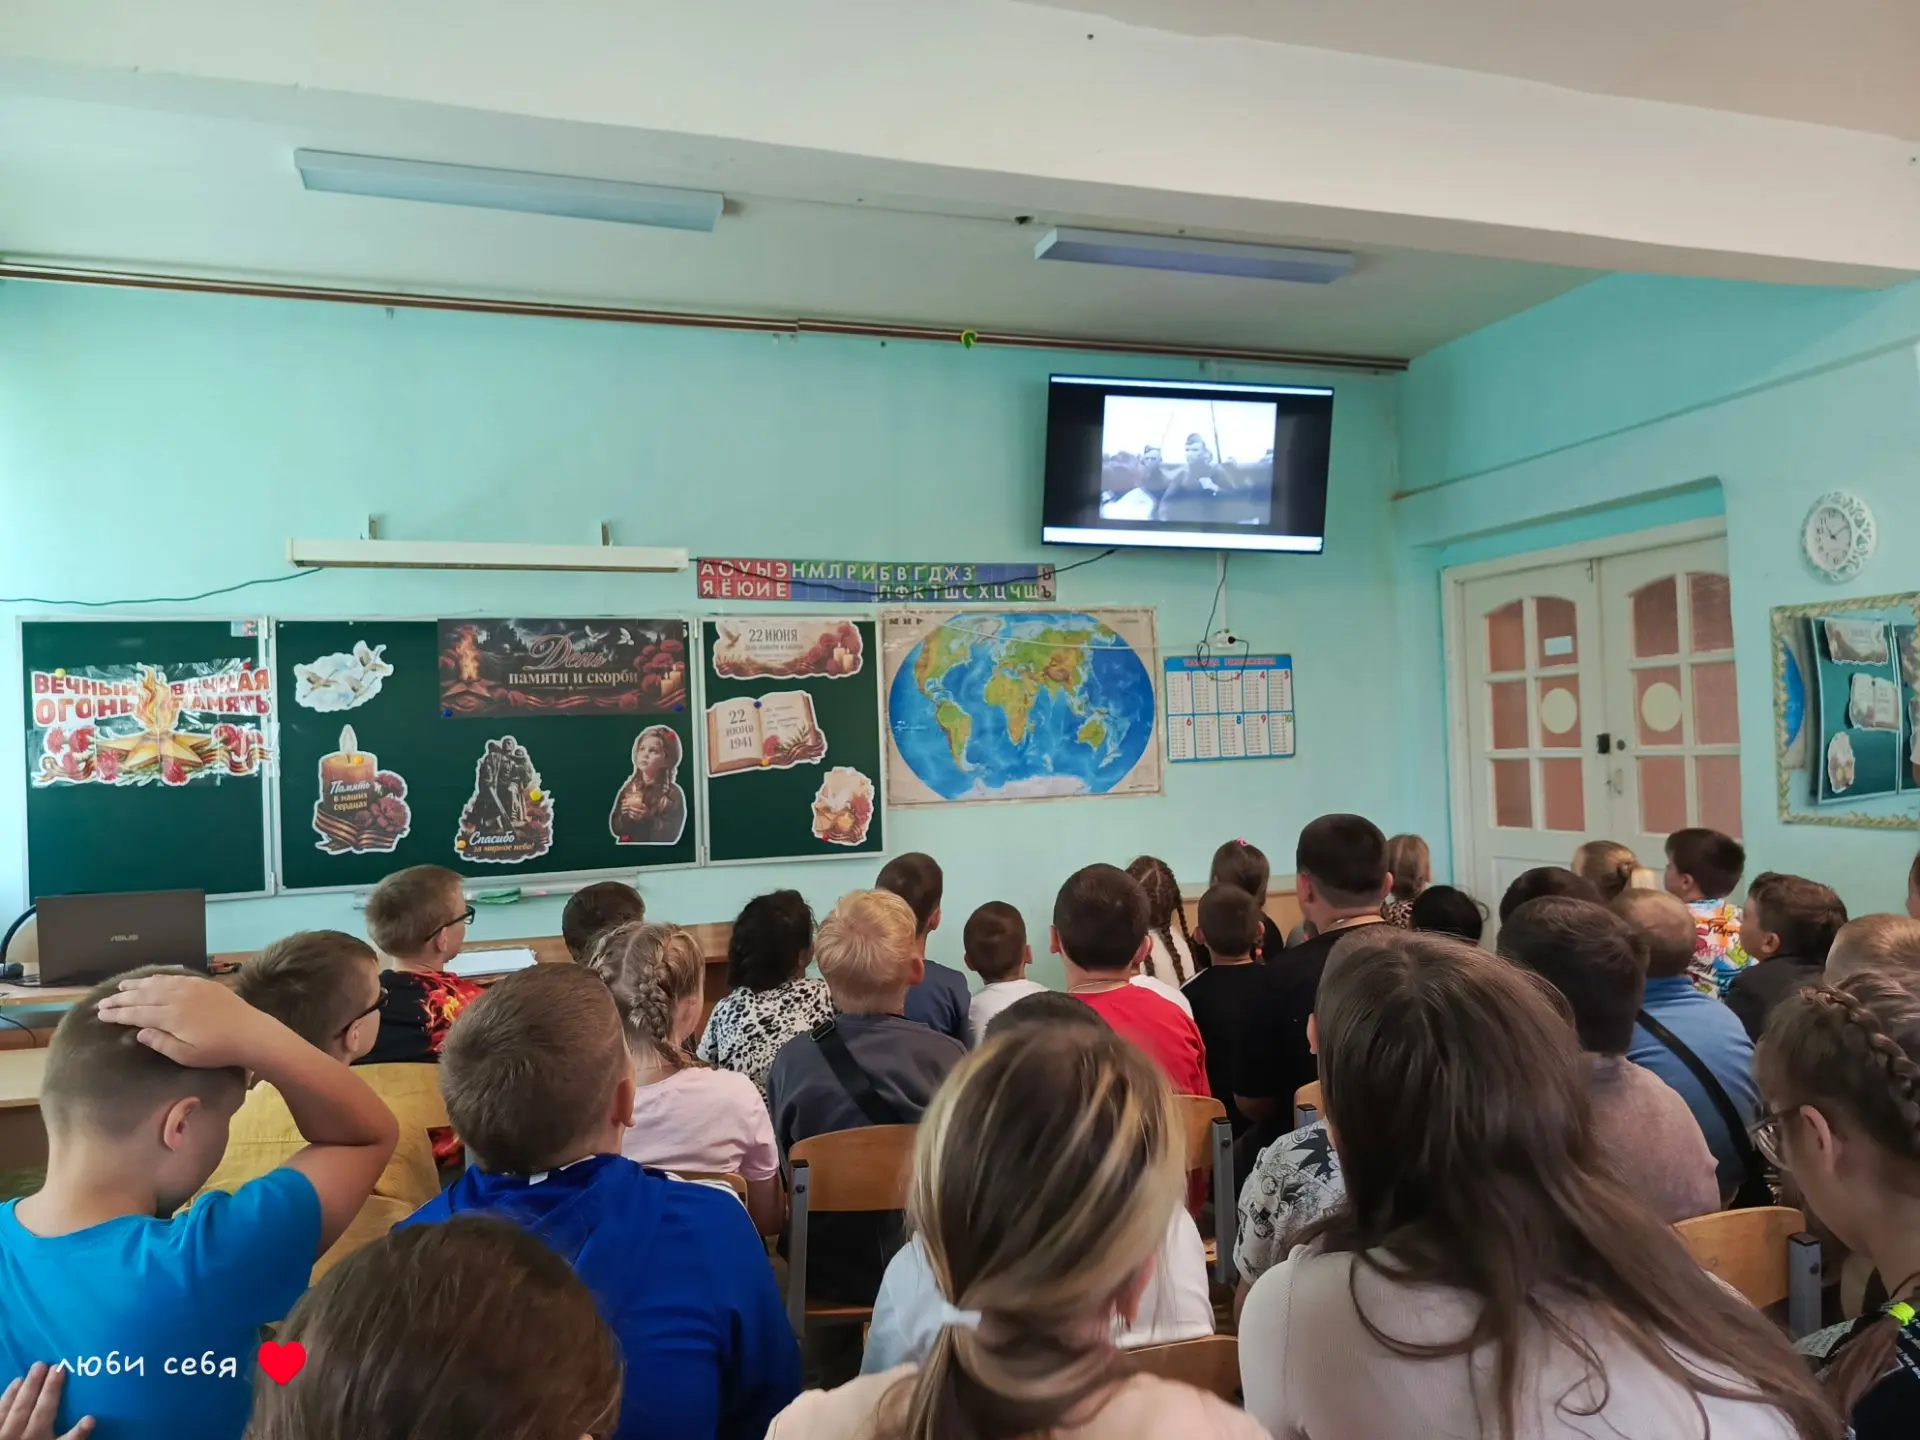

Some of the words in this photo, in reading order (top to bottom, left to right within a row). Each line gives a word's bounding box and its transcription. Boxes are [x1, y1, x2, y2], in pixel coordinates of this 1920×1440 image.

[748, 628, 763, 643] 22
[765, 628, 798, 642] ИЮНЯ
[523, 632, 607, 671] День
[34, 673, 137, 696] ВЕЧНЫЙ
[509, 671, 569, 685] памяти
[573, 672, 583, 684] и
[587, 670, 639, 687] скорби
[36, 698, 134, 725] ОГОНЬ
[729, 709, 747, 725] 22
[730, 736, 753, 750] 1941
[329, 780, 371, 795] Память
[469, 831, 515, 846] Спасибо
[110, 934, 139, 942] ASUS
